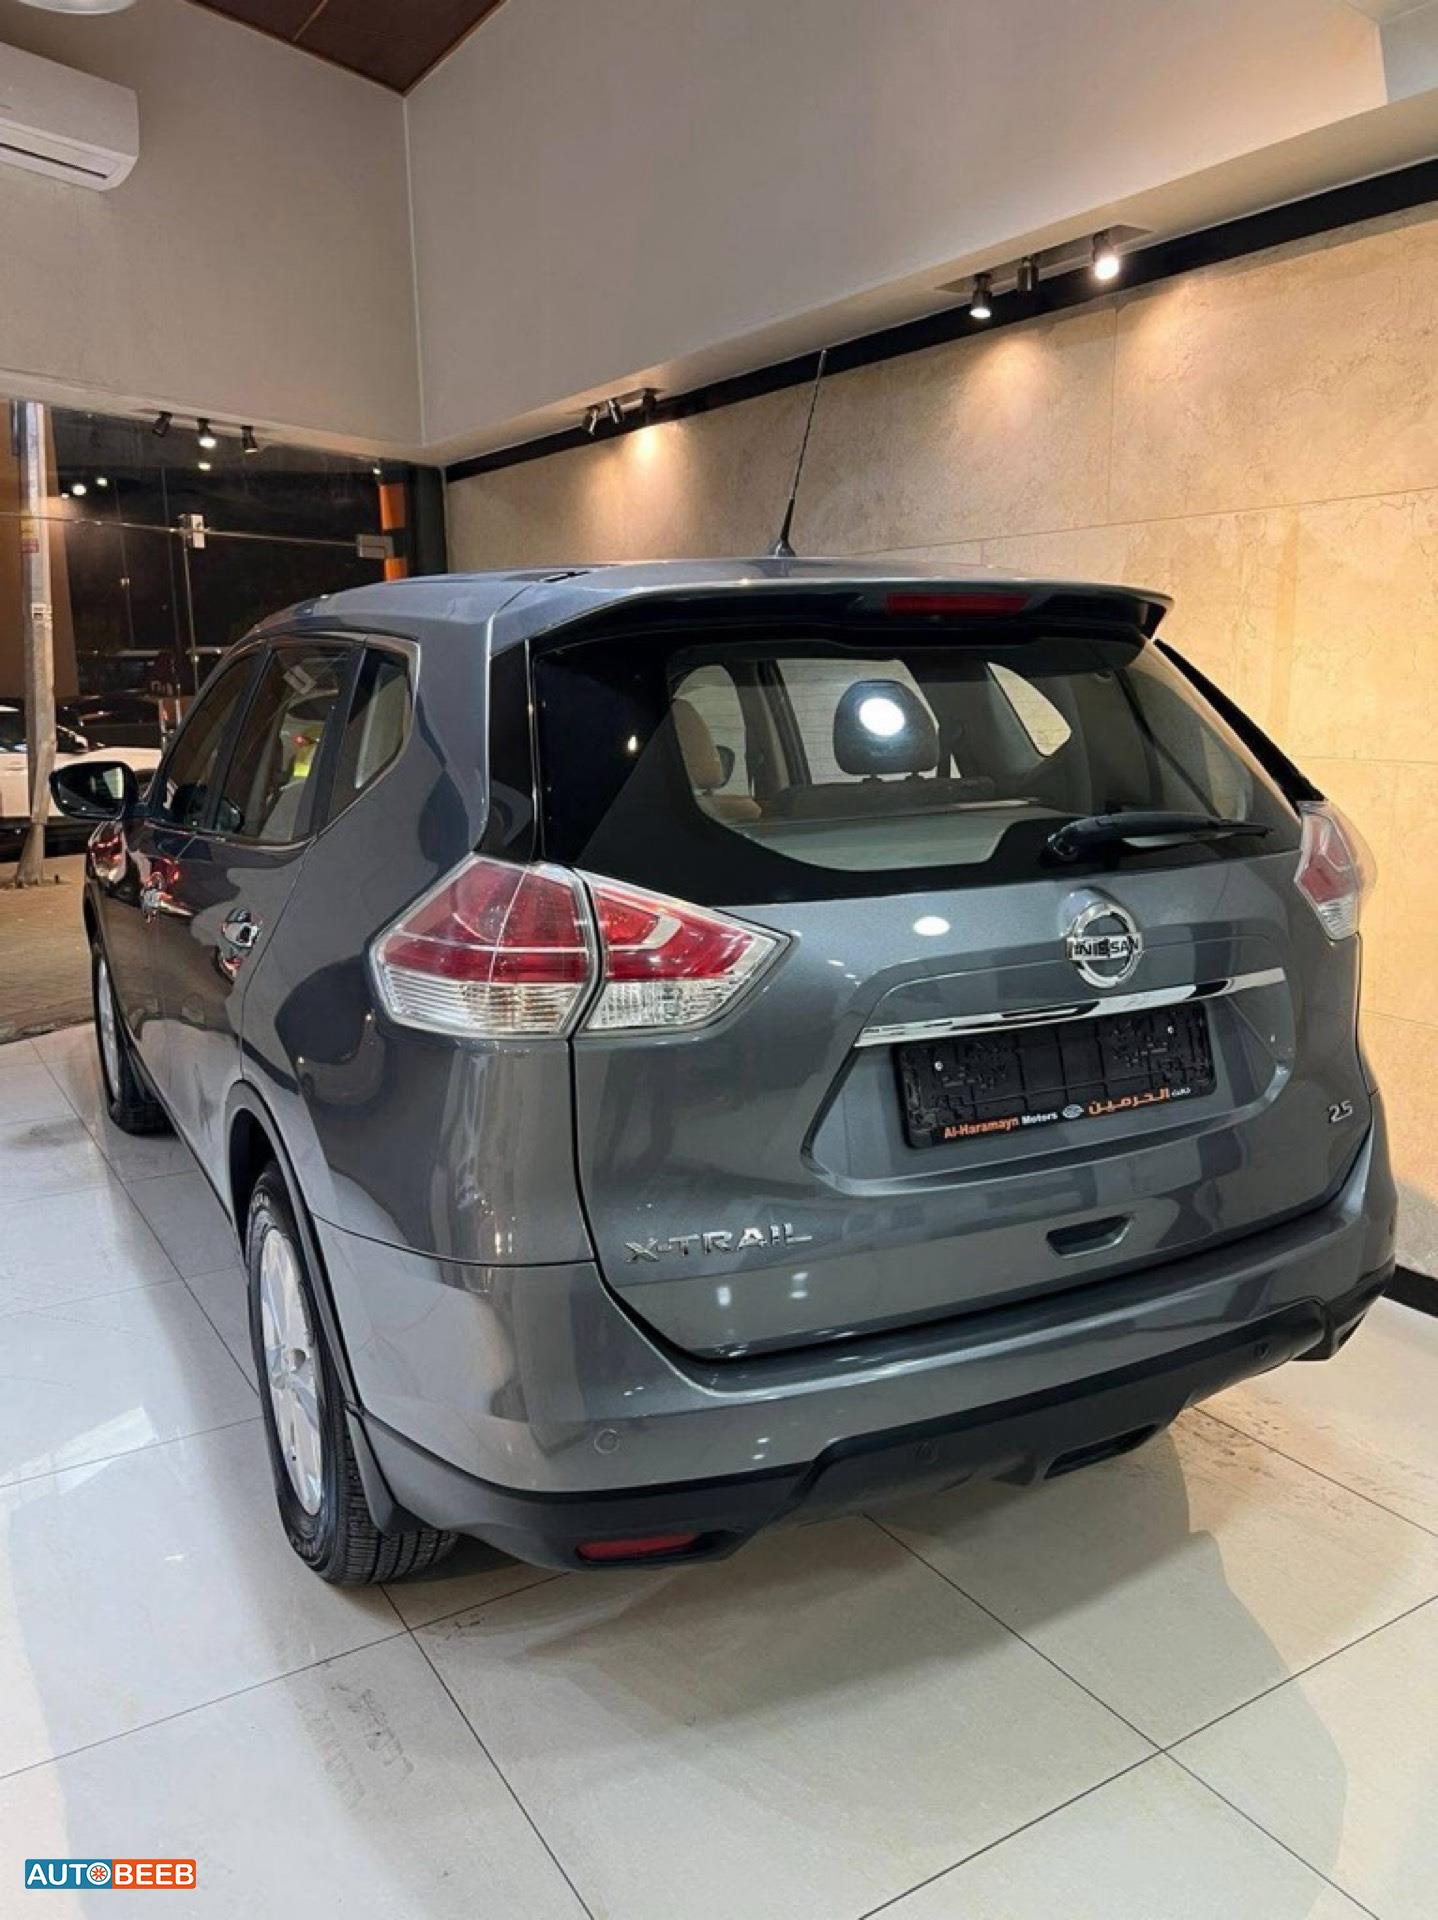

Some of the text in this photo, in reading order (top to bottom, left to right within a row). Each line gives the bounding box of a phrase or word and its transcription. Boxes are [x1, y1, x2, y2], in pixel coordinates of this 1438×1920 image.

[1075, 935, 1140, 957] NISSAN
[944, 1111, 1058, 1139] Al-Haramayn Motors
[624, 1222, 813, 1263] X-TRAIL
